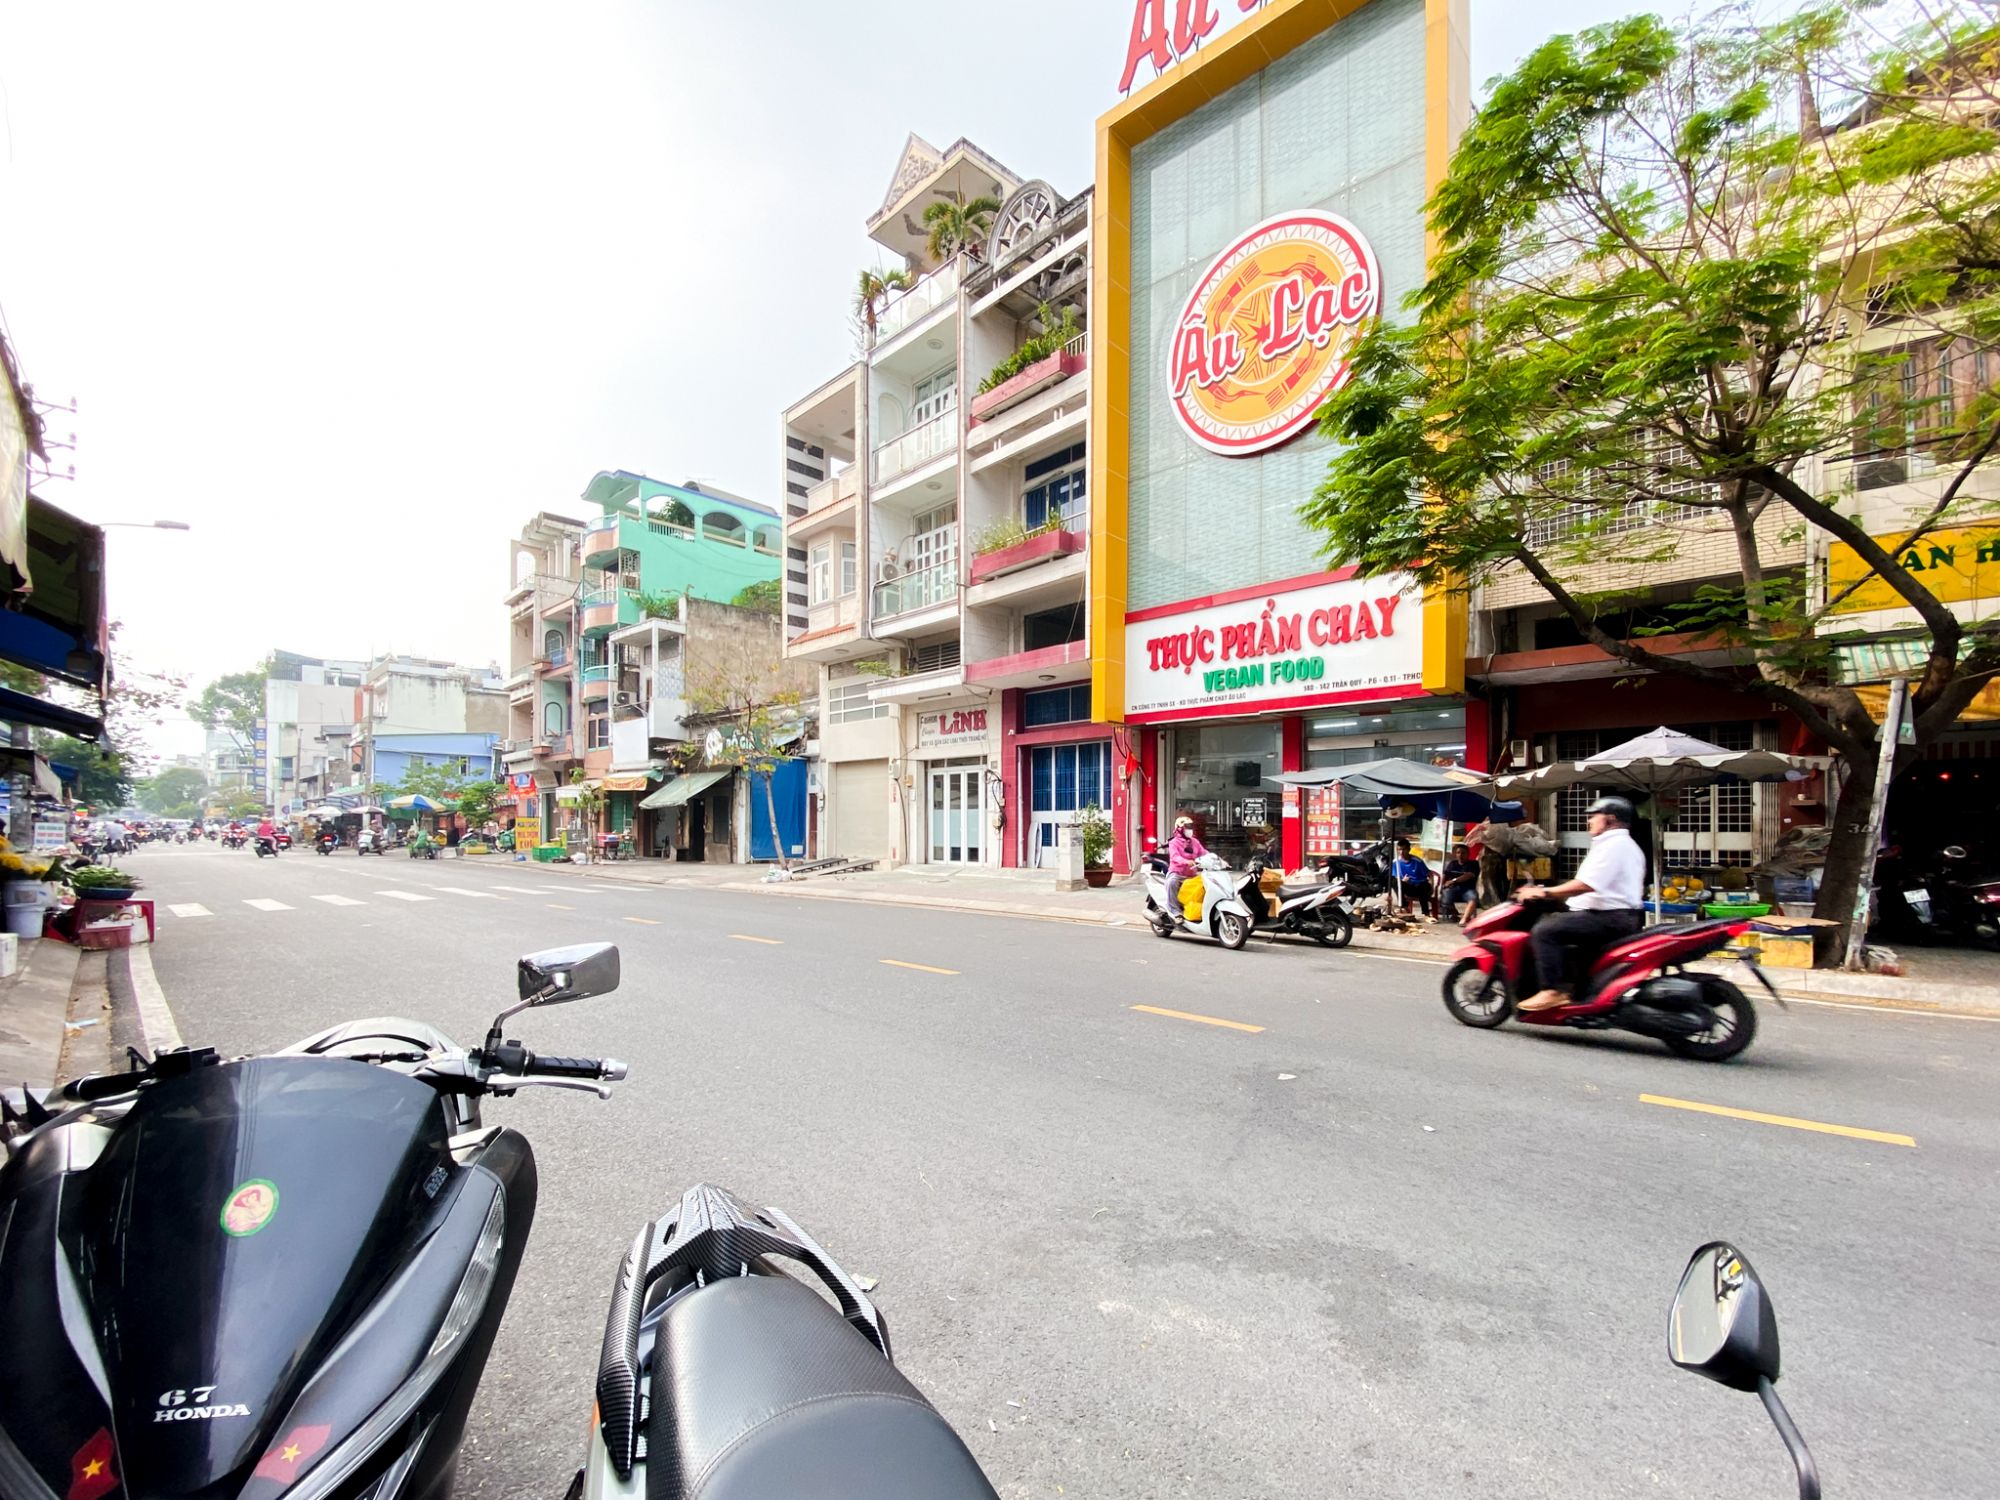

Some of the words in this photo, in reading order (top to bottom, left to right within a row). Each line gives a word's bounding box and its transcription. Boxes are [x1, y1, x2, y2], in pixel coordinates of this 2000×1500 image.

[1174, 313, 1243, 394] Âu
[1262, 271, 1370, 356] Lạc
[1147, 625, 1215, 675] THỰC
[1221, 598, 1302, 661] PHẨM
[1307, 595, 1401, 647] CHAY
[1203, 664, 1265, 693] VEGAN
[1270, 655, 1325, 686] FOOD
[153, 1403, 252, 1422] HONDA
